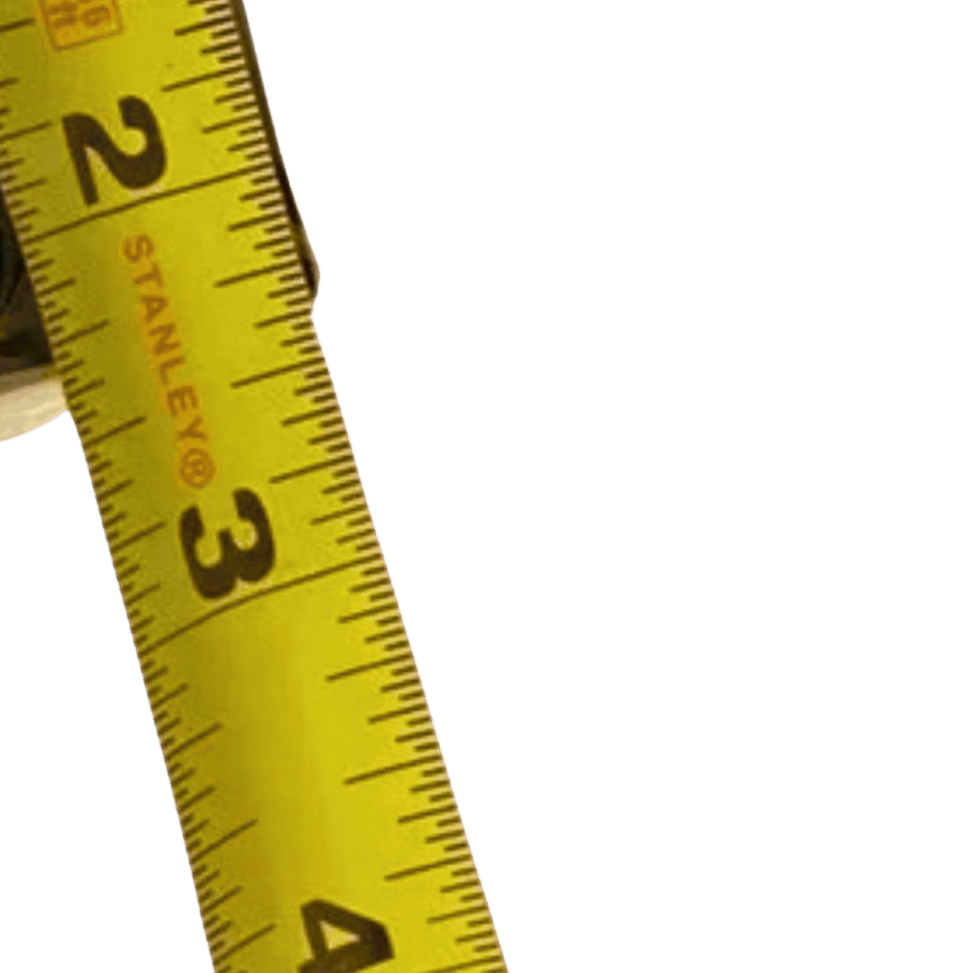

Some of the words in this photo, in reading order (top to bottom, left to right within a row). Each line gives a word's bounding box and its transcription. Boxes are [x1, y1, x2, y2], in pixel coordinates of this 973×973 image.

[61, 95, 167, 204] 2
[179, 487, 276, 600] 3
[297, 898, 395, 973] 4
